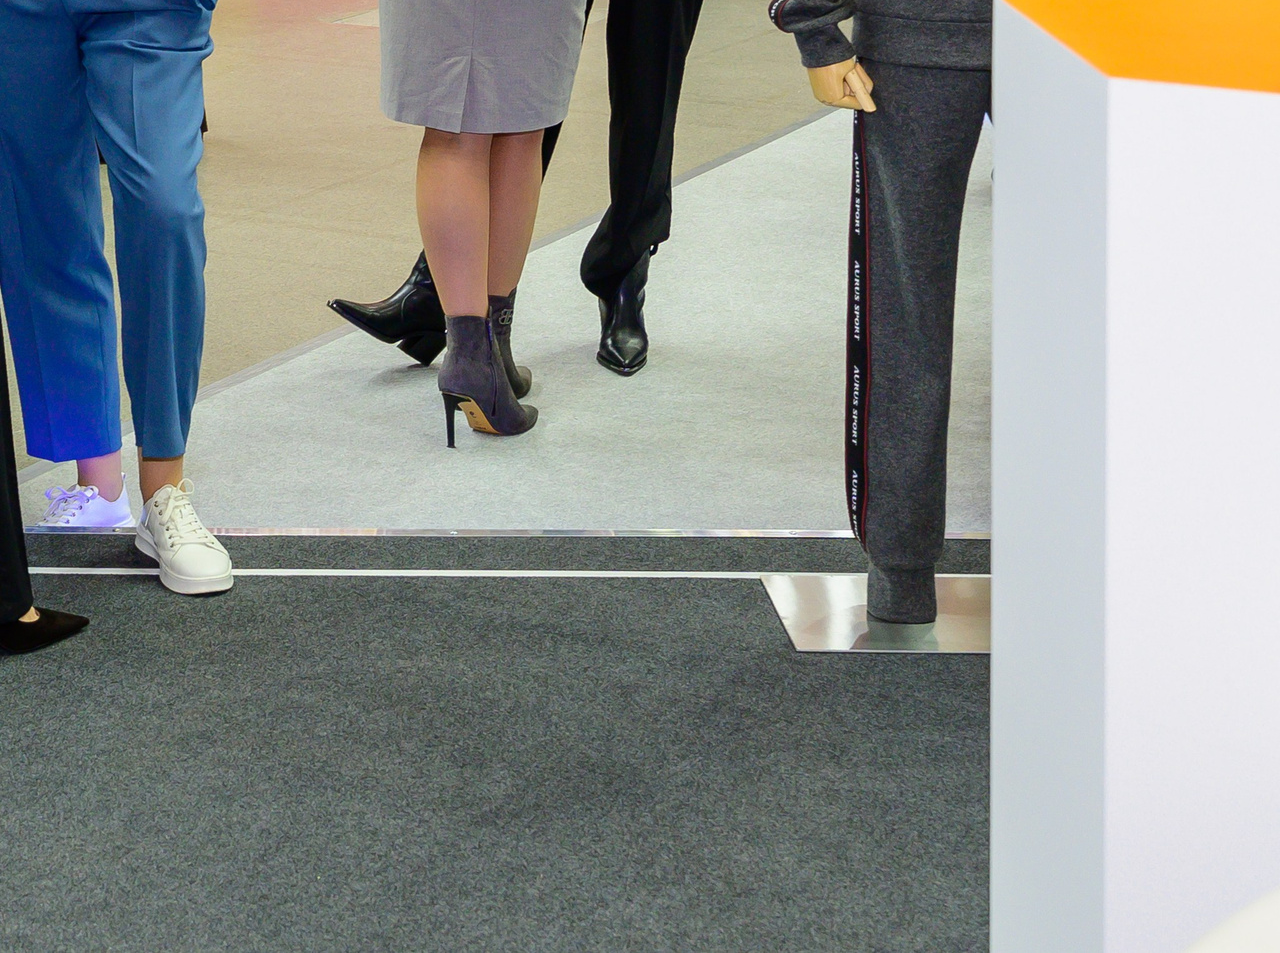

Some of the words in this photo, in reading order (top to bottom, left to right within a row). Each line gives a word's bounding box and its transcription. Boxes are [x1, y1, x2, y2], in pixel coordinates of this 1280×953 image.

[853, 303, 861, 342] SPORT
[851, 408, 860, 446] SPORT
[851, 469, 859, 513] AURUS
